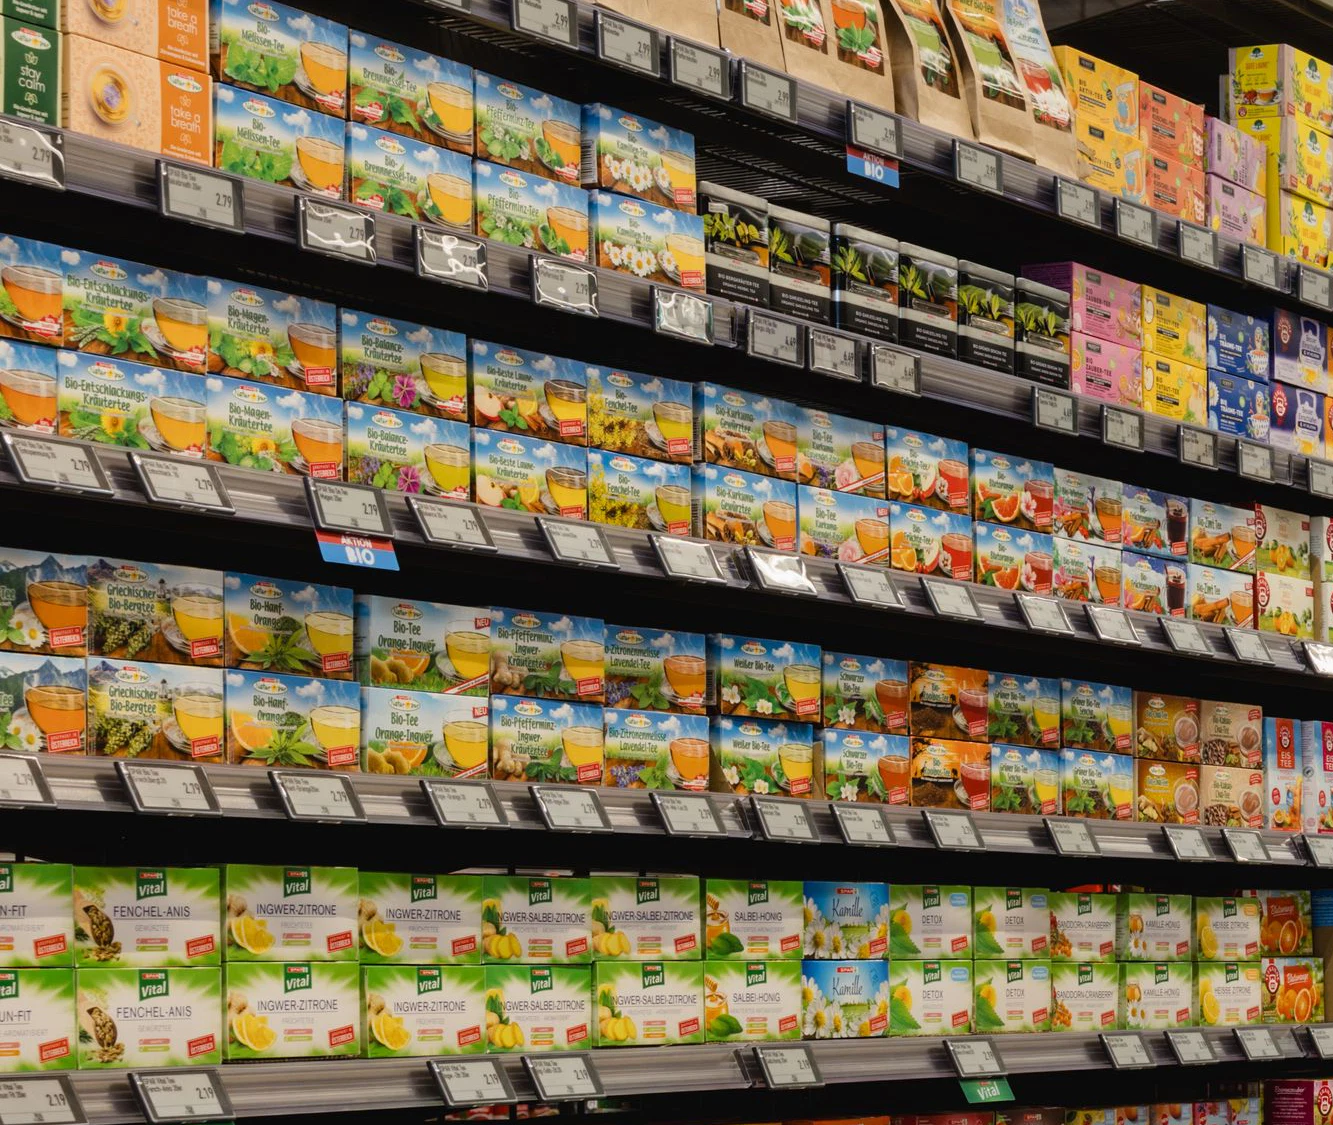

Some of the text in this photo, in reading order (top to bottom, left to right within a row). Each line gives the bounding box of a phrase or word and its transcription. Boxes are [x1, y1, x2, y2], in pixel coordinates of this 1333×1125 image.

[20, 64, 42, 80] stay
[18, 77, 46, 93] calm
[170, 104, 191, 120] take
[170, 116, 201, 134] breath
[32, 148, 51, 163] 2.79
[65, 377, 148, 402] Bio-Entschlackungs-
[83, 393, 131, 412] Kräutertee
[229, 402, 272, 420] Bio-Magen-
[228, 415, 273, 434] Kräutertee
[70, 458, 90, 472] 2.79
[345, 545, 375, 566] BIO
[108, 684, 158, 700] Griechischer
[110, 699, 157, 716] Bio-Bergtee
[391, 712, 419, 727] Bio-Tee
[182, 783, 201, 796] 2.79
[139, 880, 165, 897] Vital
[286, 880, 310, 896] Vital
[113, 905, 190, 918] FENCHEL-ANIS
[256, 904, 337, 916] INGWER-ZITRONE
[386, 908, 461, 921] INGWER-ZITRONE
[833, 897, 863, 918] Kamille
[735, 911, 782, 921] SALBEI-HONIG
[922, 915, 943, 924] DETOX
[833, 975, 863, 997] Kamille
[116, 1005, 192, 1019] FENCHEL-ANIS
[257, 999, 338, 1011] INGWER-ZITRONE
[46, 1093, 66, 1107] 2.19
[196, 1087, 215, 1100] 2.19
